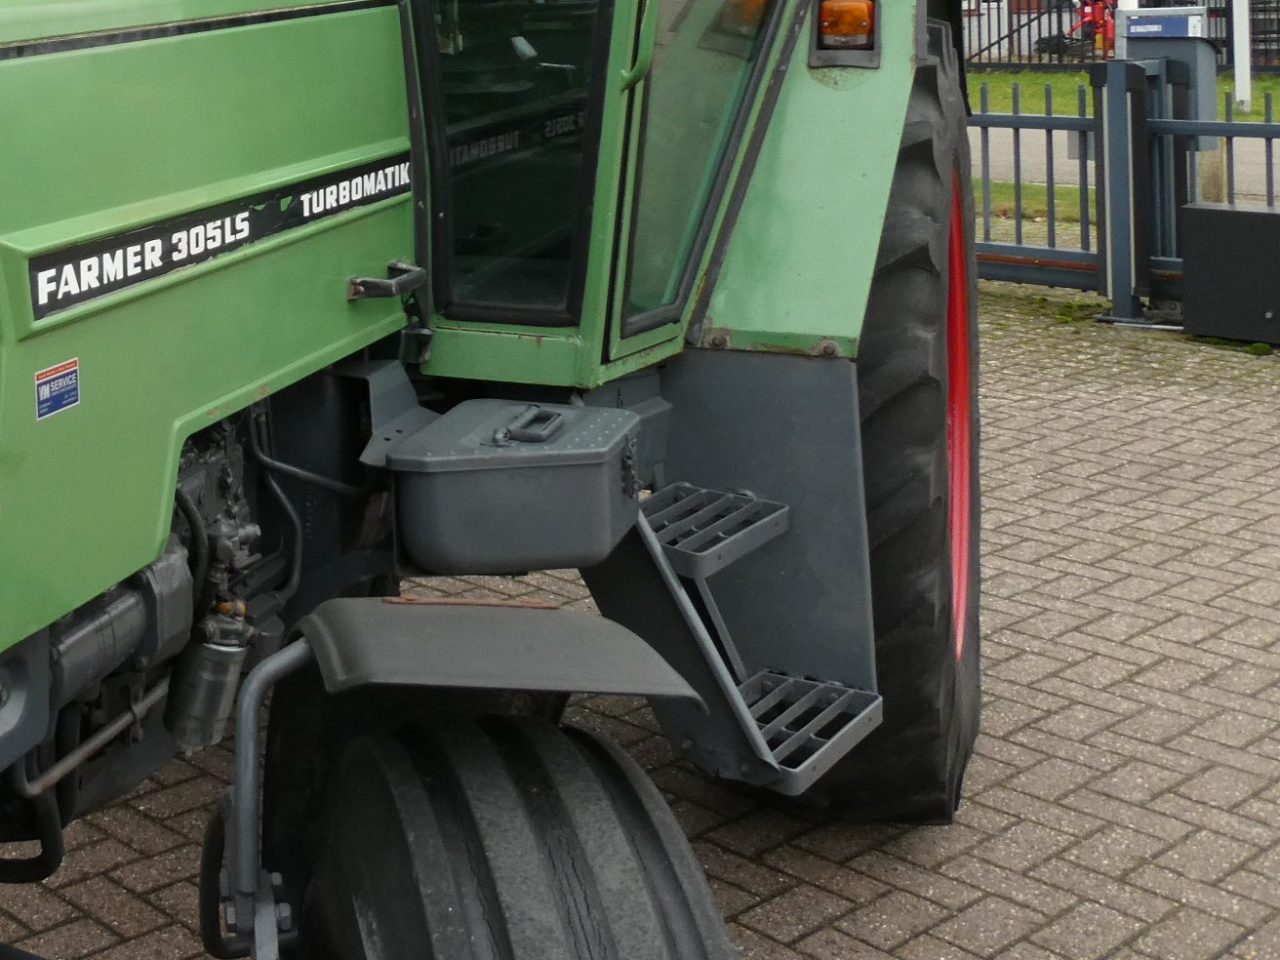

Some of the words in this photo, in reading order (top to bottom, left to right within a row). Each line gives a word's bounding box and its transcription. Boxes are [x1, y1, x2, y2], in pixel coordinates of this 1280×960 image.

[36, 238, 163, 306] FARMER
[171, 211, 250, 262] 305LS
[300, 161, 411, 217] TURBOMATIK
[50, 372, 77, 392] SERVICE
